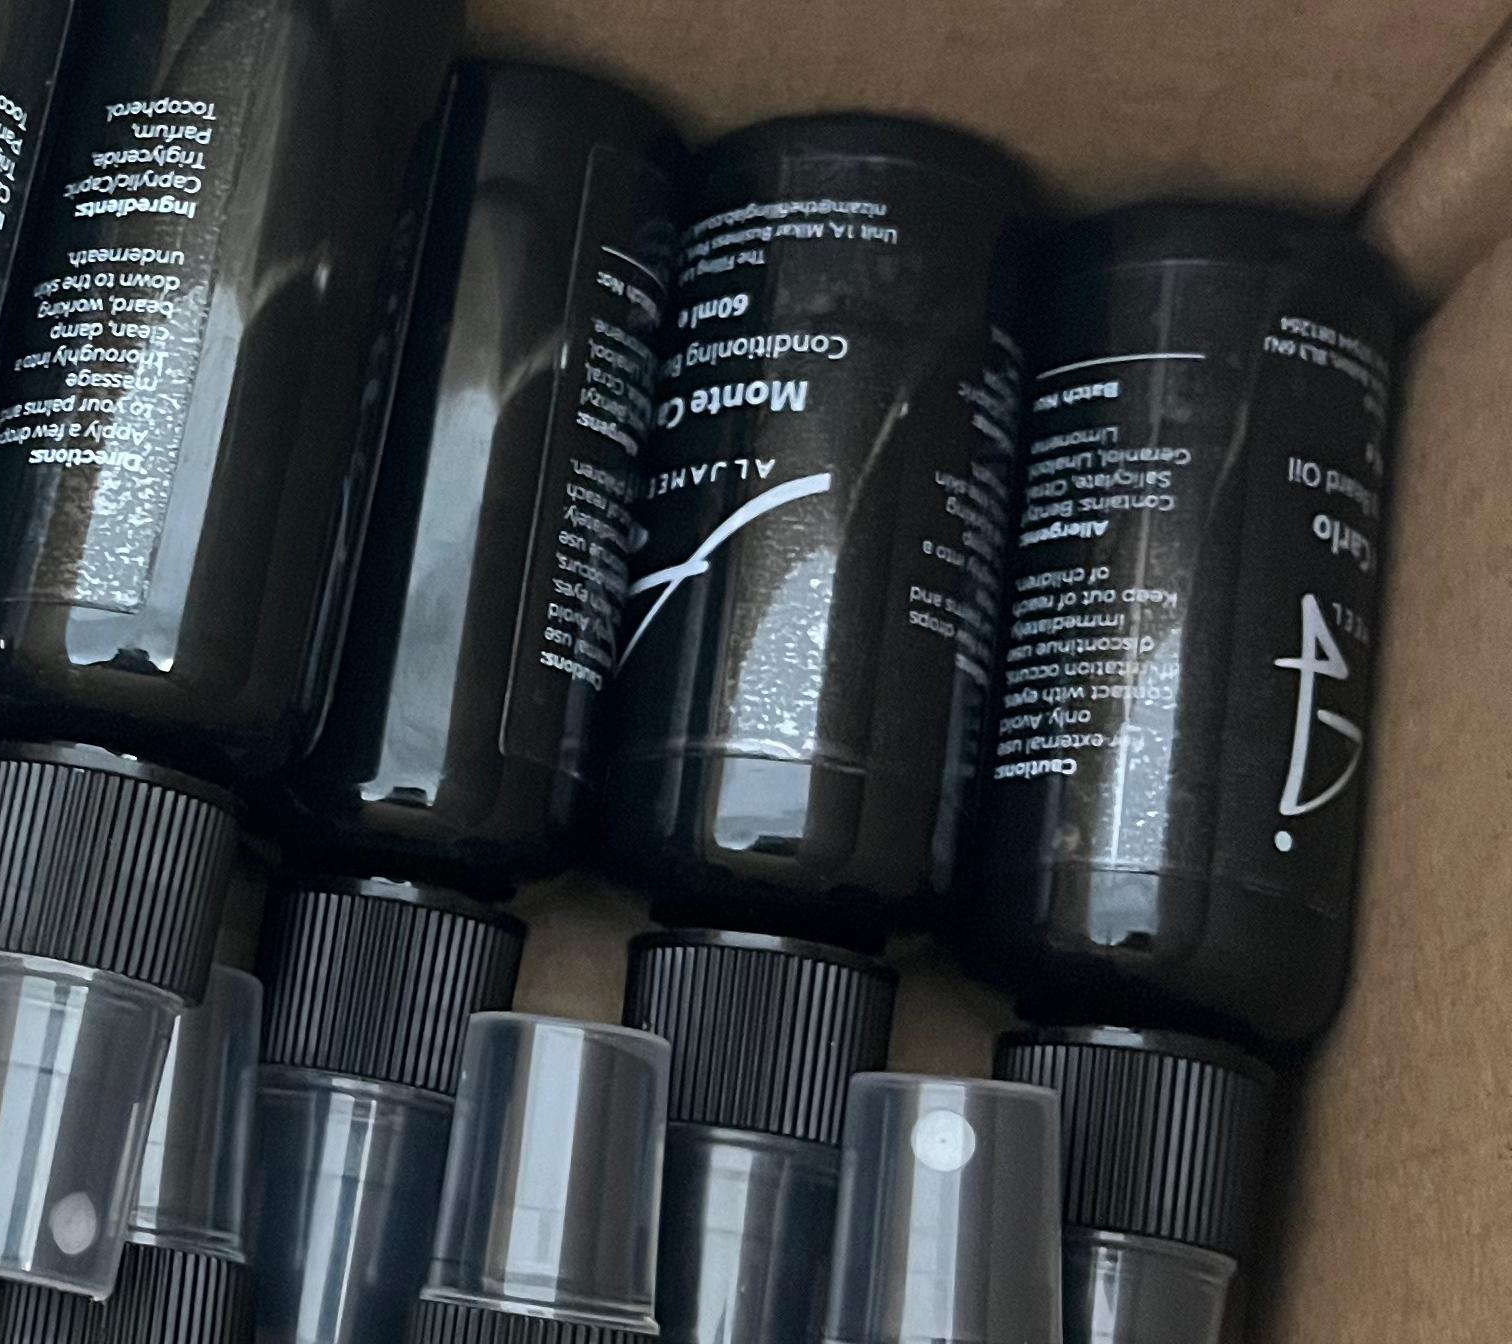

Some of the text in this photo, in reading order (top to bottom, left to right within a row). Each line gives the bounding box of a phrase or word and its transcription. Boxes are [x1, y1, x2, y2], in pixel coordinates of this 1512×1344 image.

[131, 123, 212, 144] Parfum,
[691, 293, 749, 326] 60ml
[65, 372, 158, 392] massage
[691, 379, 809, 415] Monte
[1287, 455, 1321, 484] Oil
[1082, 587, 1116, 605] out
[1121, 586, 1178, 609] Keep
